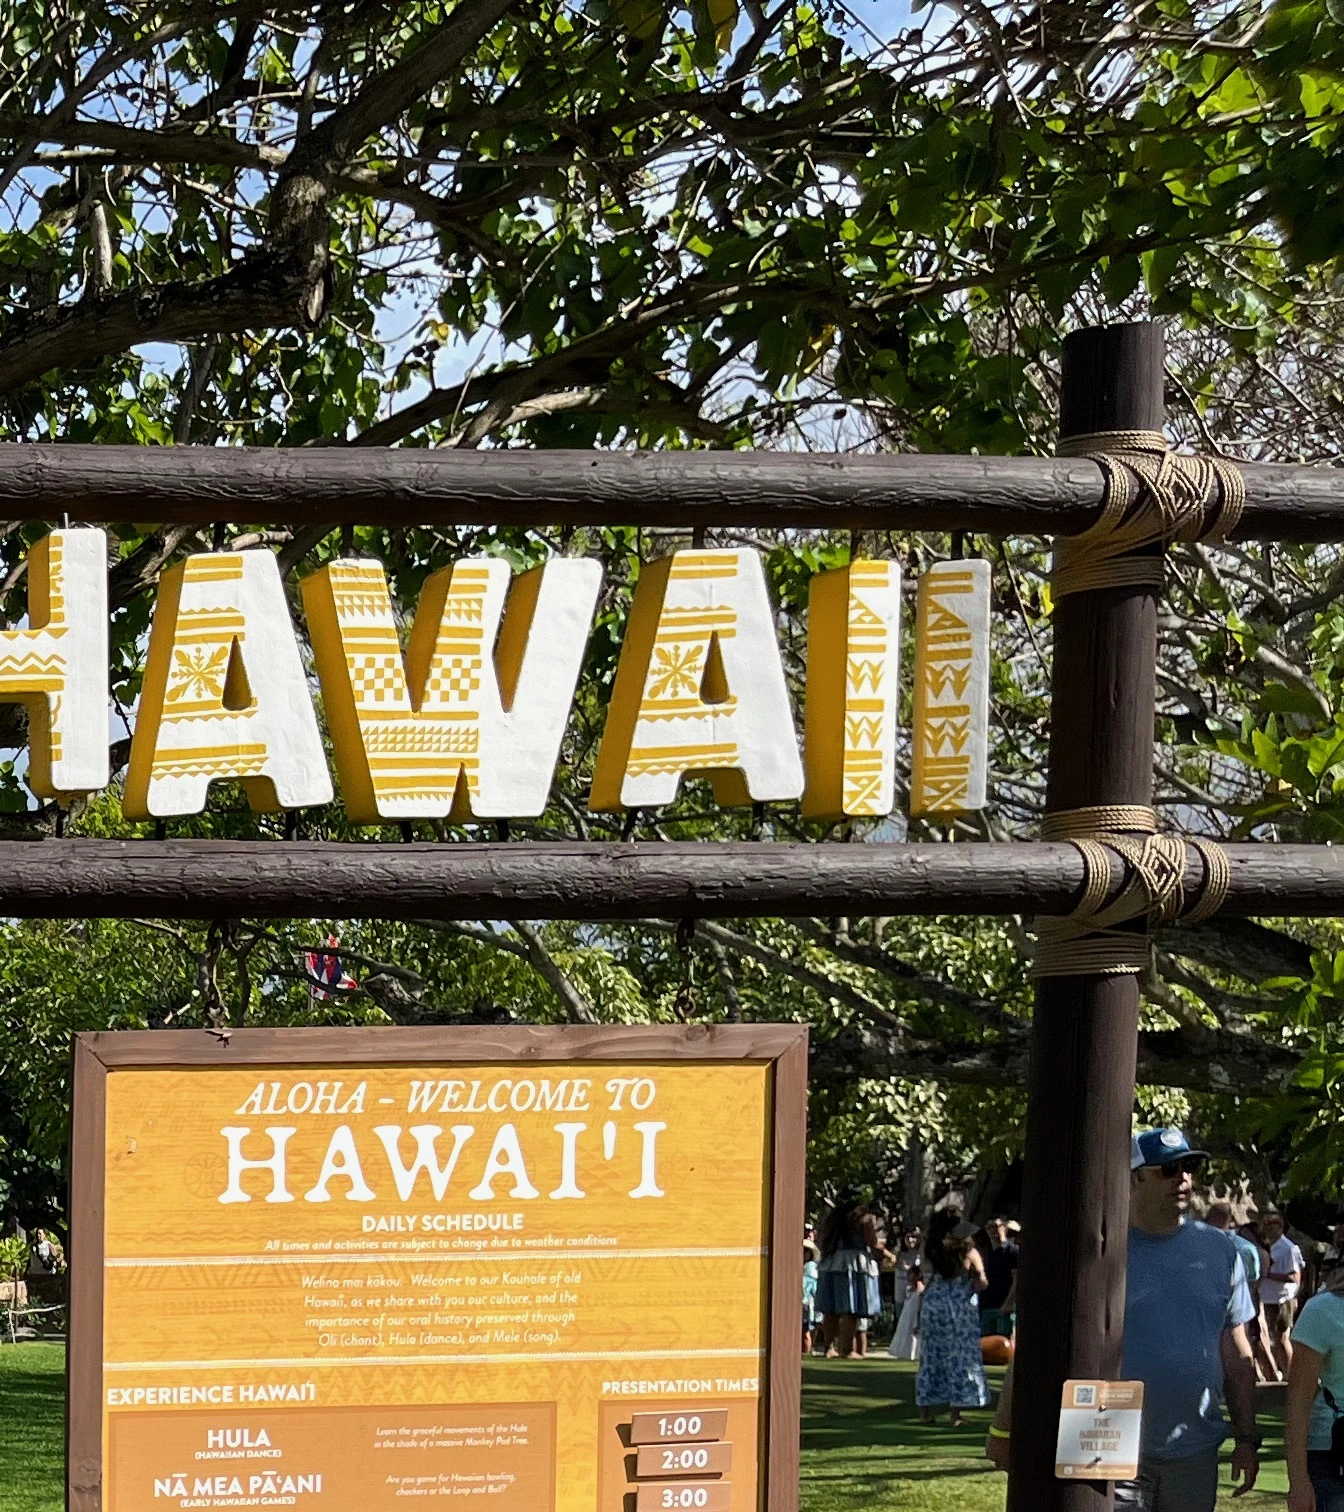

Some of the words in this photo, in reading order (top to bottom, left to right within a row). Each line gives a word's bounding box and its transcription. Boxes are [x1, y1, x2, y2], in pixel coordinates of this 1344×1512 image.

[234, 1081, 367, 1115] ALOHA
[406, 1079, 592, 1114] WELCOME
[605, 1077, 657, 1110] TO
[218, 1120, 668, 1203] HAWAI'I
[362, 1215, 417, 1233] DAILY
[422, 1213, 524, 1231] SCHEDULE
[265, 1240, 280, 1251] All
[282, 1240, 310, 1250] times
[312, 1239, 331, 1250] and
[334, 1238, 379, 1249] activities
[382, 1240, 398, 1249] are
[401, 1237, 436, 1252] subject
[439, 1239, 449, 1248] to
[452, 1237, 488, 1251] change
[491, 1236, 508, 1247] due
[512, 1236, 521, 1247] to
[525, 1234, 564, 1246] weather
[566, 1233, 617, 1246] conditions
[411, 1273, 462, 1287] Welcome
[465, 1275, 476, 1286] to
[480, 1276, 499, 1285] our
[550, 1271, 563, 1288] of
[564, 1271, 582, 1284] old
[351, 1298, 362, 1307] as
[366, 1298, 381, 1307] we
[384, 1295, 414, 1307] share
[418, 1294, 441, 1305] with
[444, 1296, 465, 1308] you
[468, 1295, 487, 1305] our
[535, 1291, 557, 1304] and
[559, 1291, 578, 1303] the
[305, 1314, 369, 1331] importance
[372, 1312, 386, 1330] of
[387, 1316, 406, 1326] our
[409, 1313, 431, 1325] oral
[434, 1312, 473, 1328] history
[476, 1311, 529, 1327] preserved
[531, 1310, 575, 1327] through
[318, 1333, 336, 1346] Oli
[389, 1332, 416, 1345] Hula
[469, 1331, 489, 1343] and
[494, 1330, 520, 1343] Mele
[107, 1385, 234, 1406] EXPERIENCE
[602, 1379, 712, 1394] PRESENTATION
[715, 1378, 759, 1392] TIMES
[658, 1416, 702, 1436] 1:00
[207, 1428, 271, 1449] HULA
[1080, 1441, 1118, 1451] VILLAGE
[195, 1450, 245, 1460] (HAWAIIAN
[247, 1449, 282, 1459] DANCE)
[661, 1449, 708, 1469] 2:00
[154, 1472, 188, 1497] NĀ
[192, 1476, 243, 1496] MEA
[661, 1488, 708, 1508] 3:00
